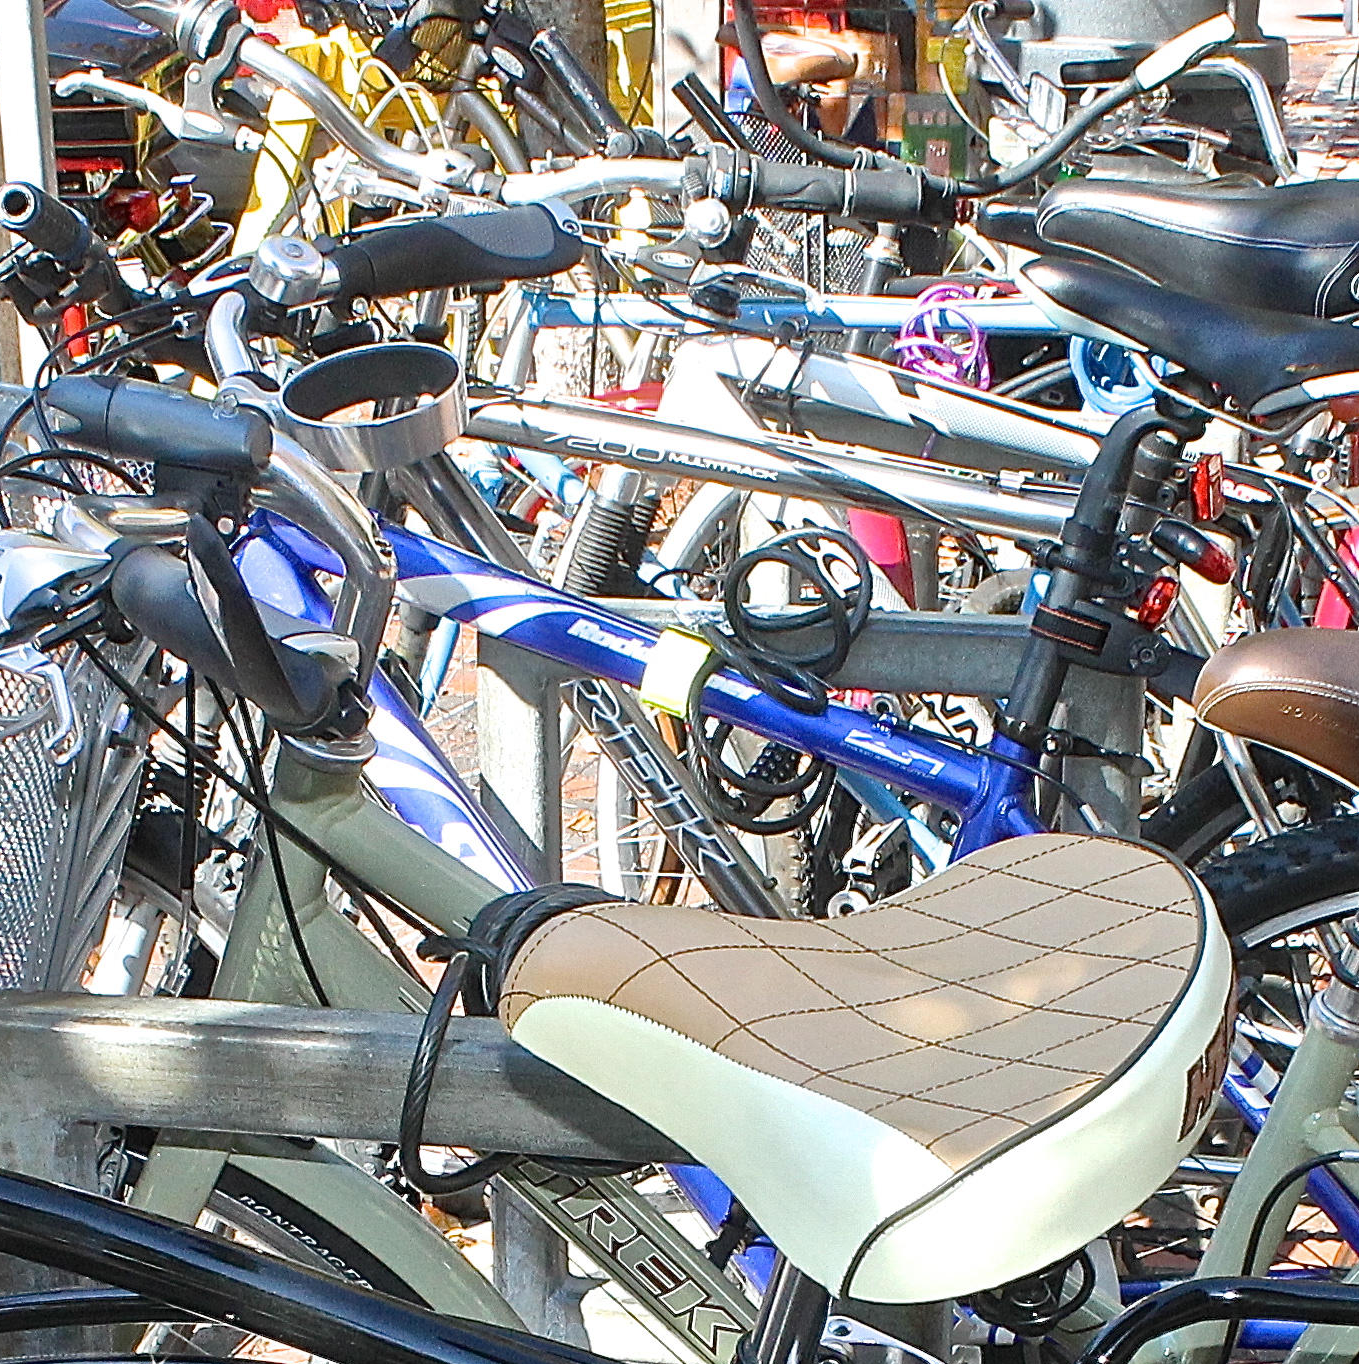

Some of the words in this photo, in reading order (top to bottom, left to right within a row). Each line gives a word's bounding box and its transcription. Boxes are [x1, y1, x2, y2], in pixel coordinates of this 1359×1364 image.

[544, 432, 665, 463] 7200
[668, 451, 780, 482] MULTITRACK
[560, 678, 738, 877] REK
